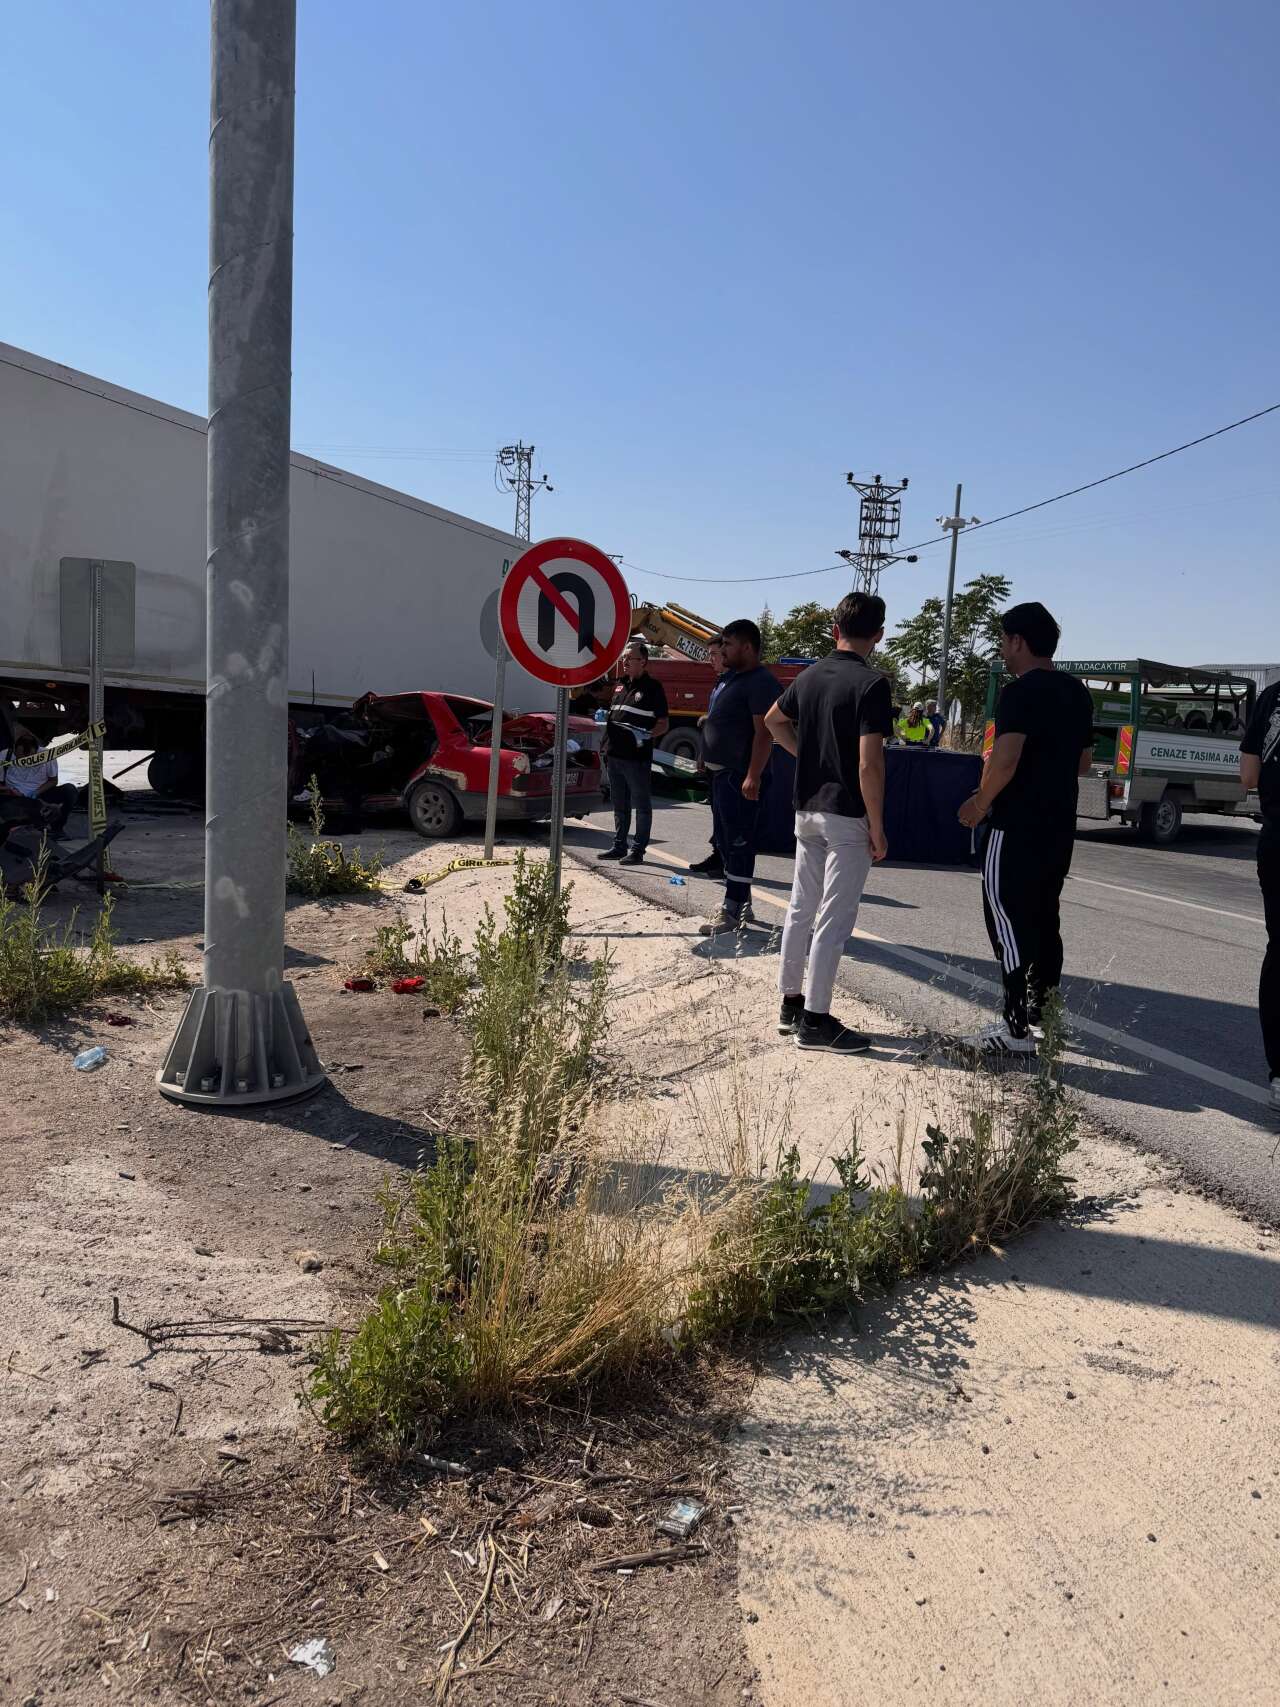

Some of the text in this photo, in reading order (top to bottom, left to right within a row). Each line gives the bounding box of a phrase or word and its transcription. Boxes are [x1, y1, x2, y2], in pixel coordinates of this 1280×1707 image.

[1075, 662, 1126, 671] TADACAKTIR
[1151, 747, 1187, 759] CENAZE
[1222, 753, 1240, 764] ARA
